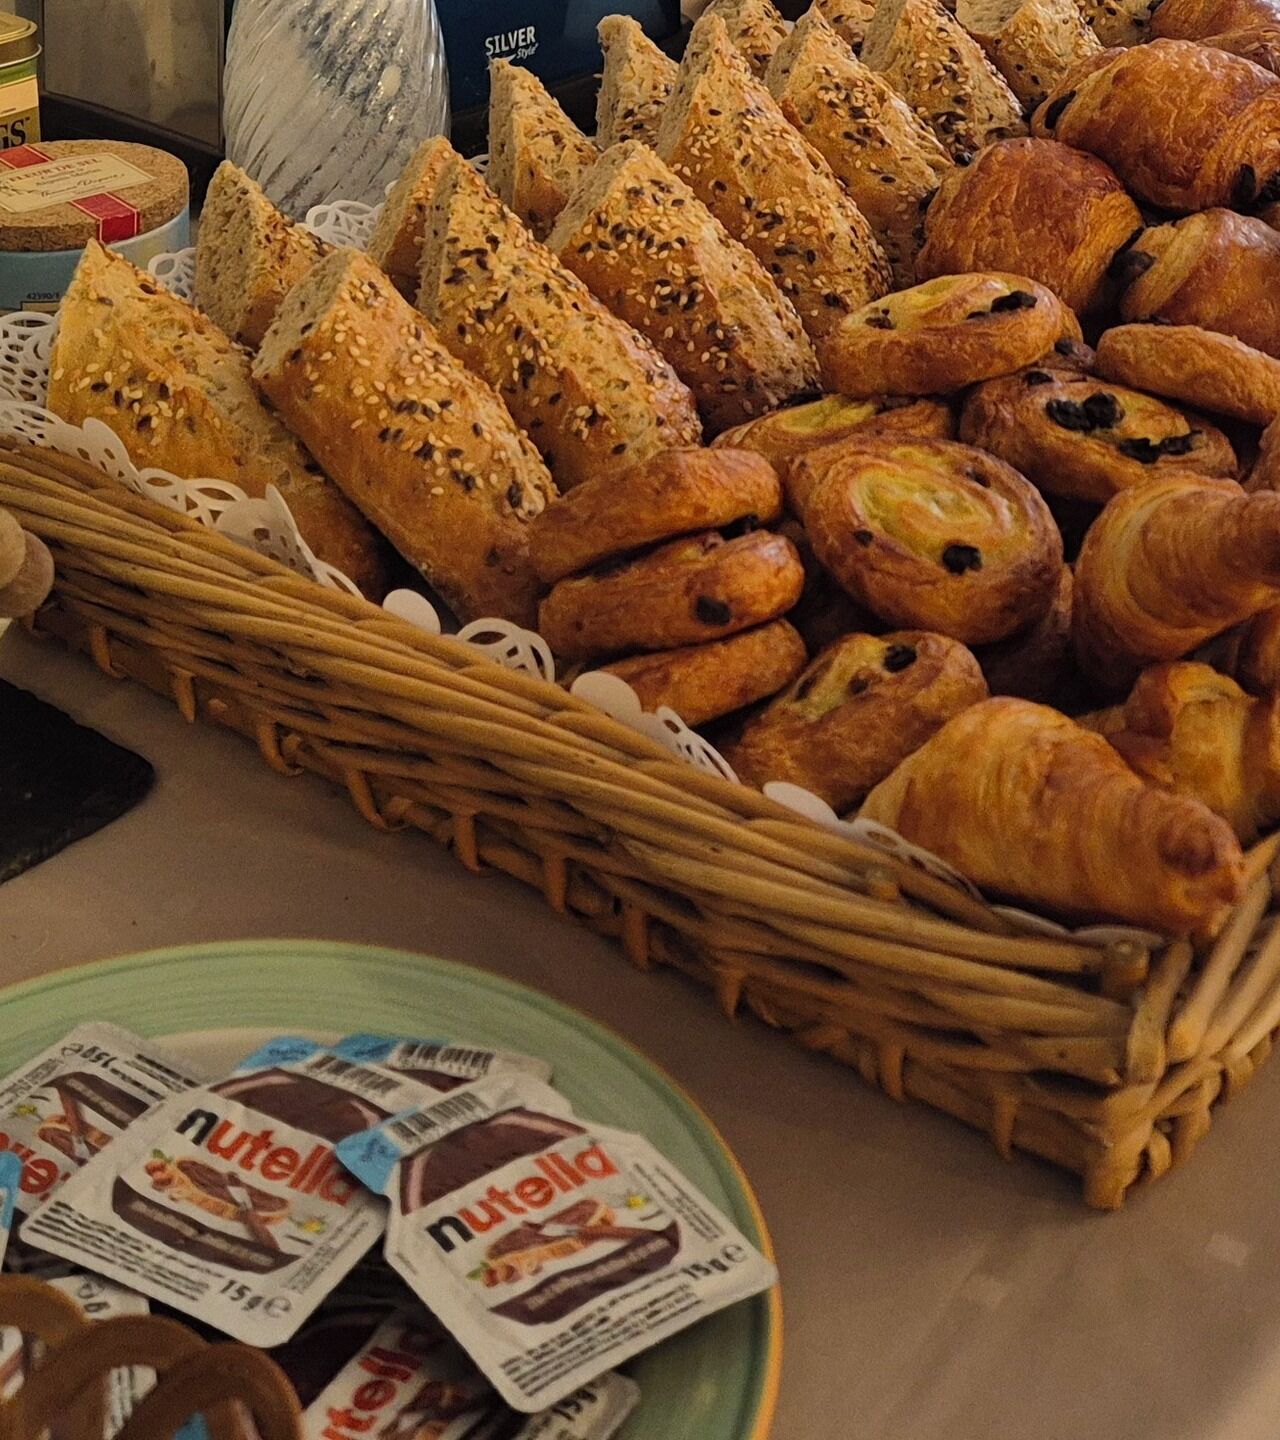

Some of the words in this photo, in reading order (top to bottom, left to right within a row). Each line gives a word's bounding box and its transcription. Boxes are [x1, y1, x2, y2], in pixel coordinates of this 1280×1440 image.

[484, 25, 536, 57] SILVER
[174, 1107, 357, 1207] nutella
[425, 1144, 620, 1254] nutella
